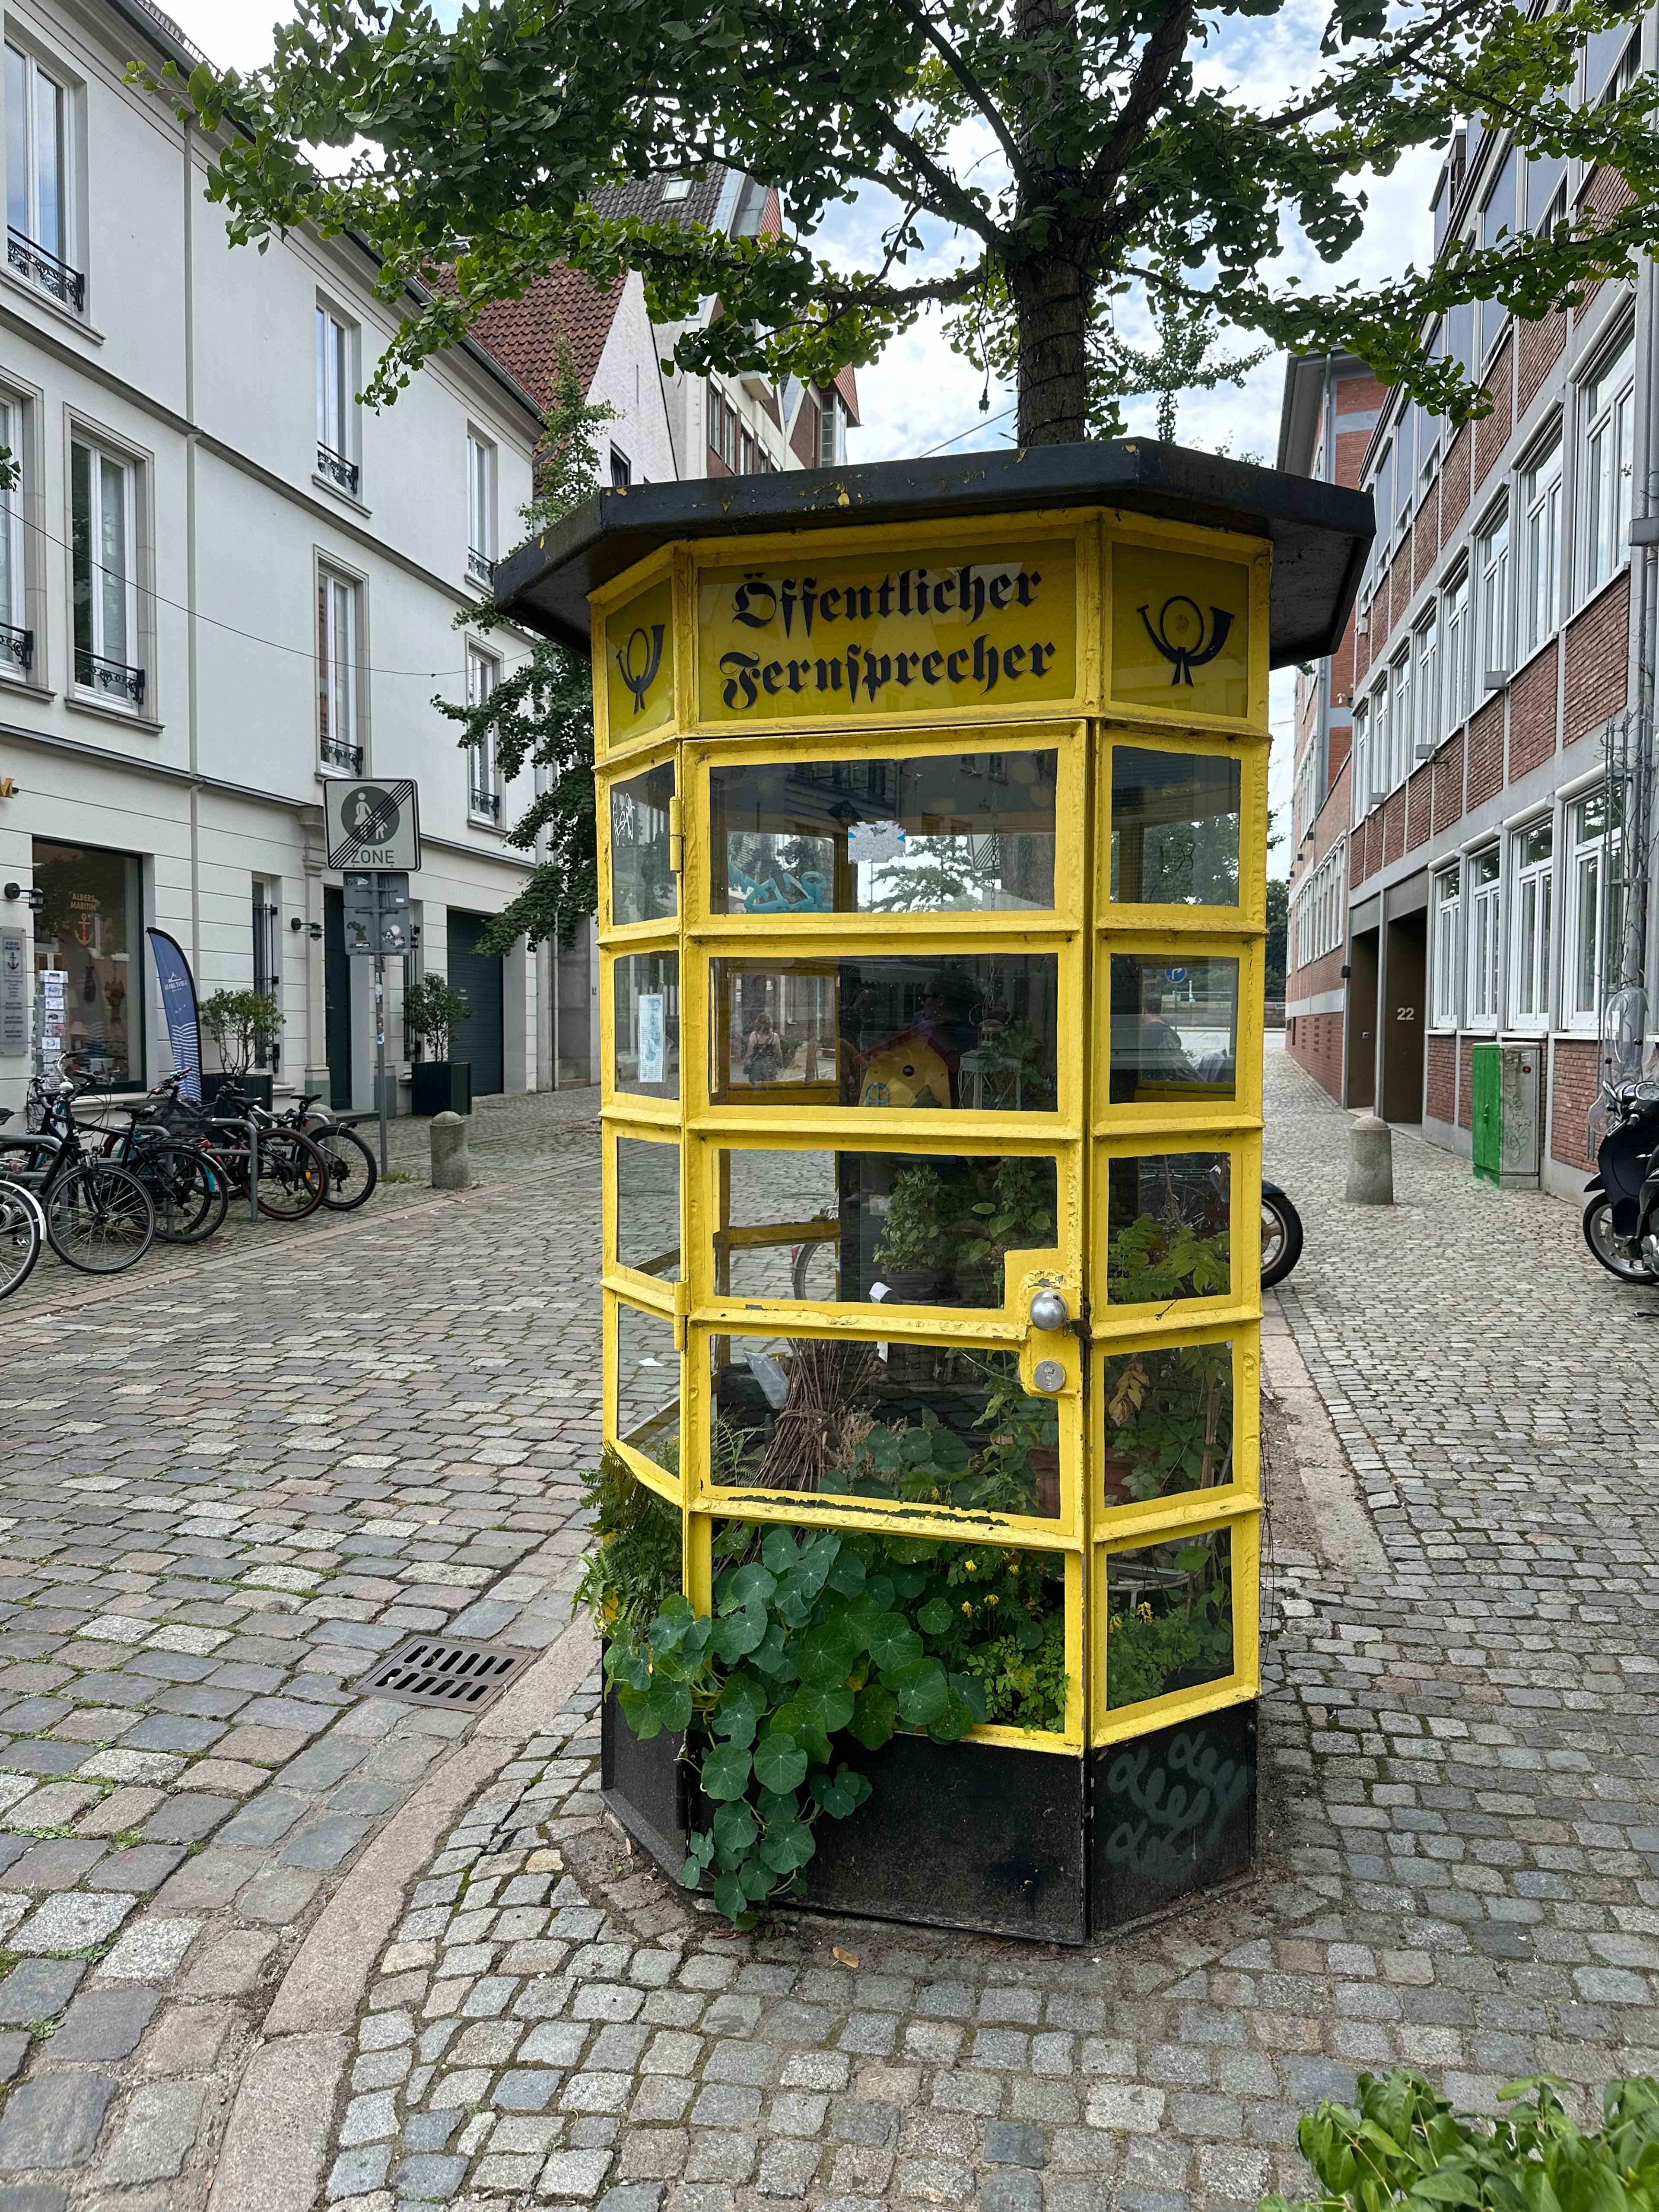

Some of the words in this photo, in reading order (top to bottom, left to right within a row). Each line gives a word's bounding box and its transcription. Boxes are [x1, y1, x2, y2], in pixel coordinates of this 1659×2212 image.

[732, 565, 1042, 639] Öffentlicher
[351, 850, 394, 864] ZONE
[70, 901, 97, 911] MARITIM
[1397, 1007, 1414, 1020] 22
